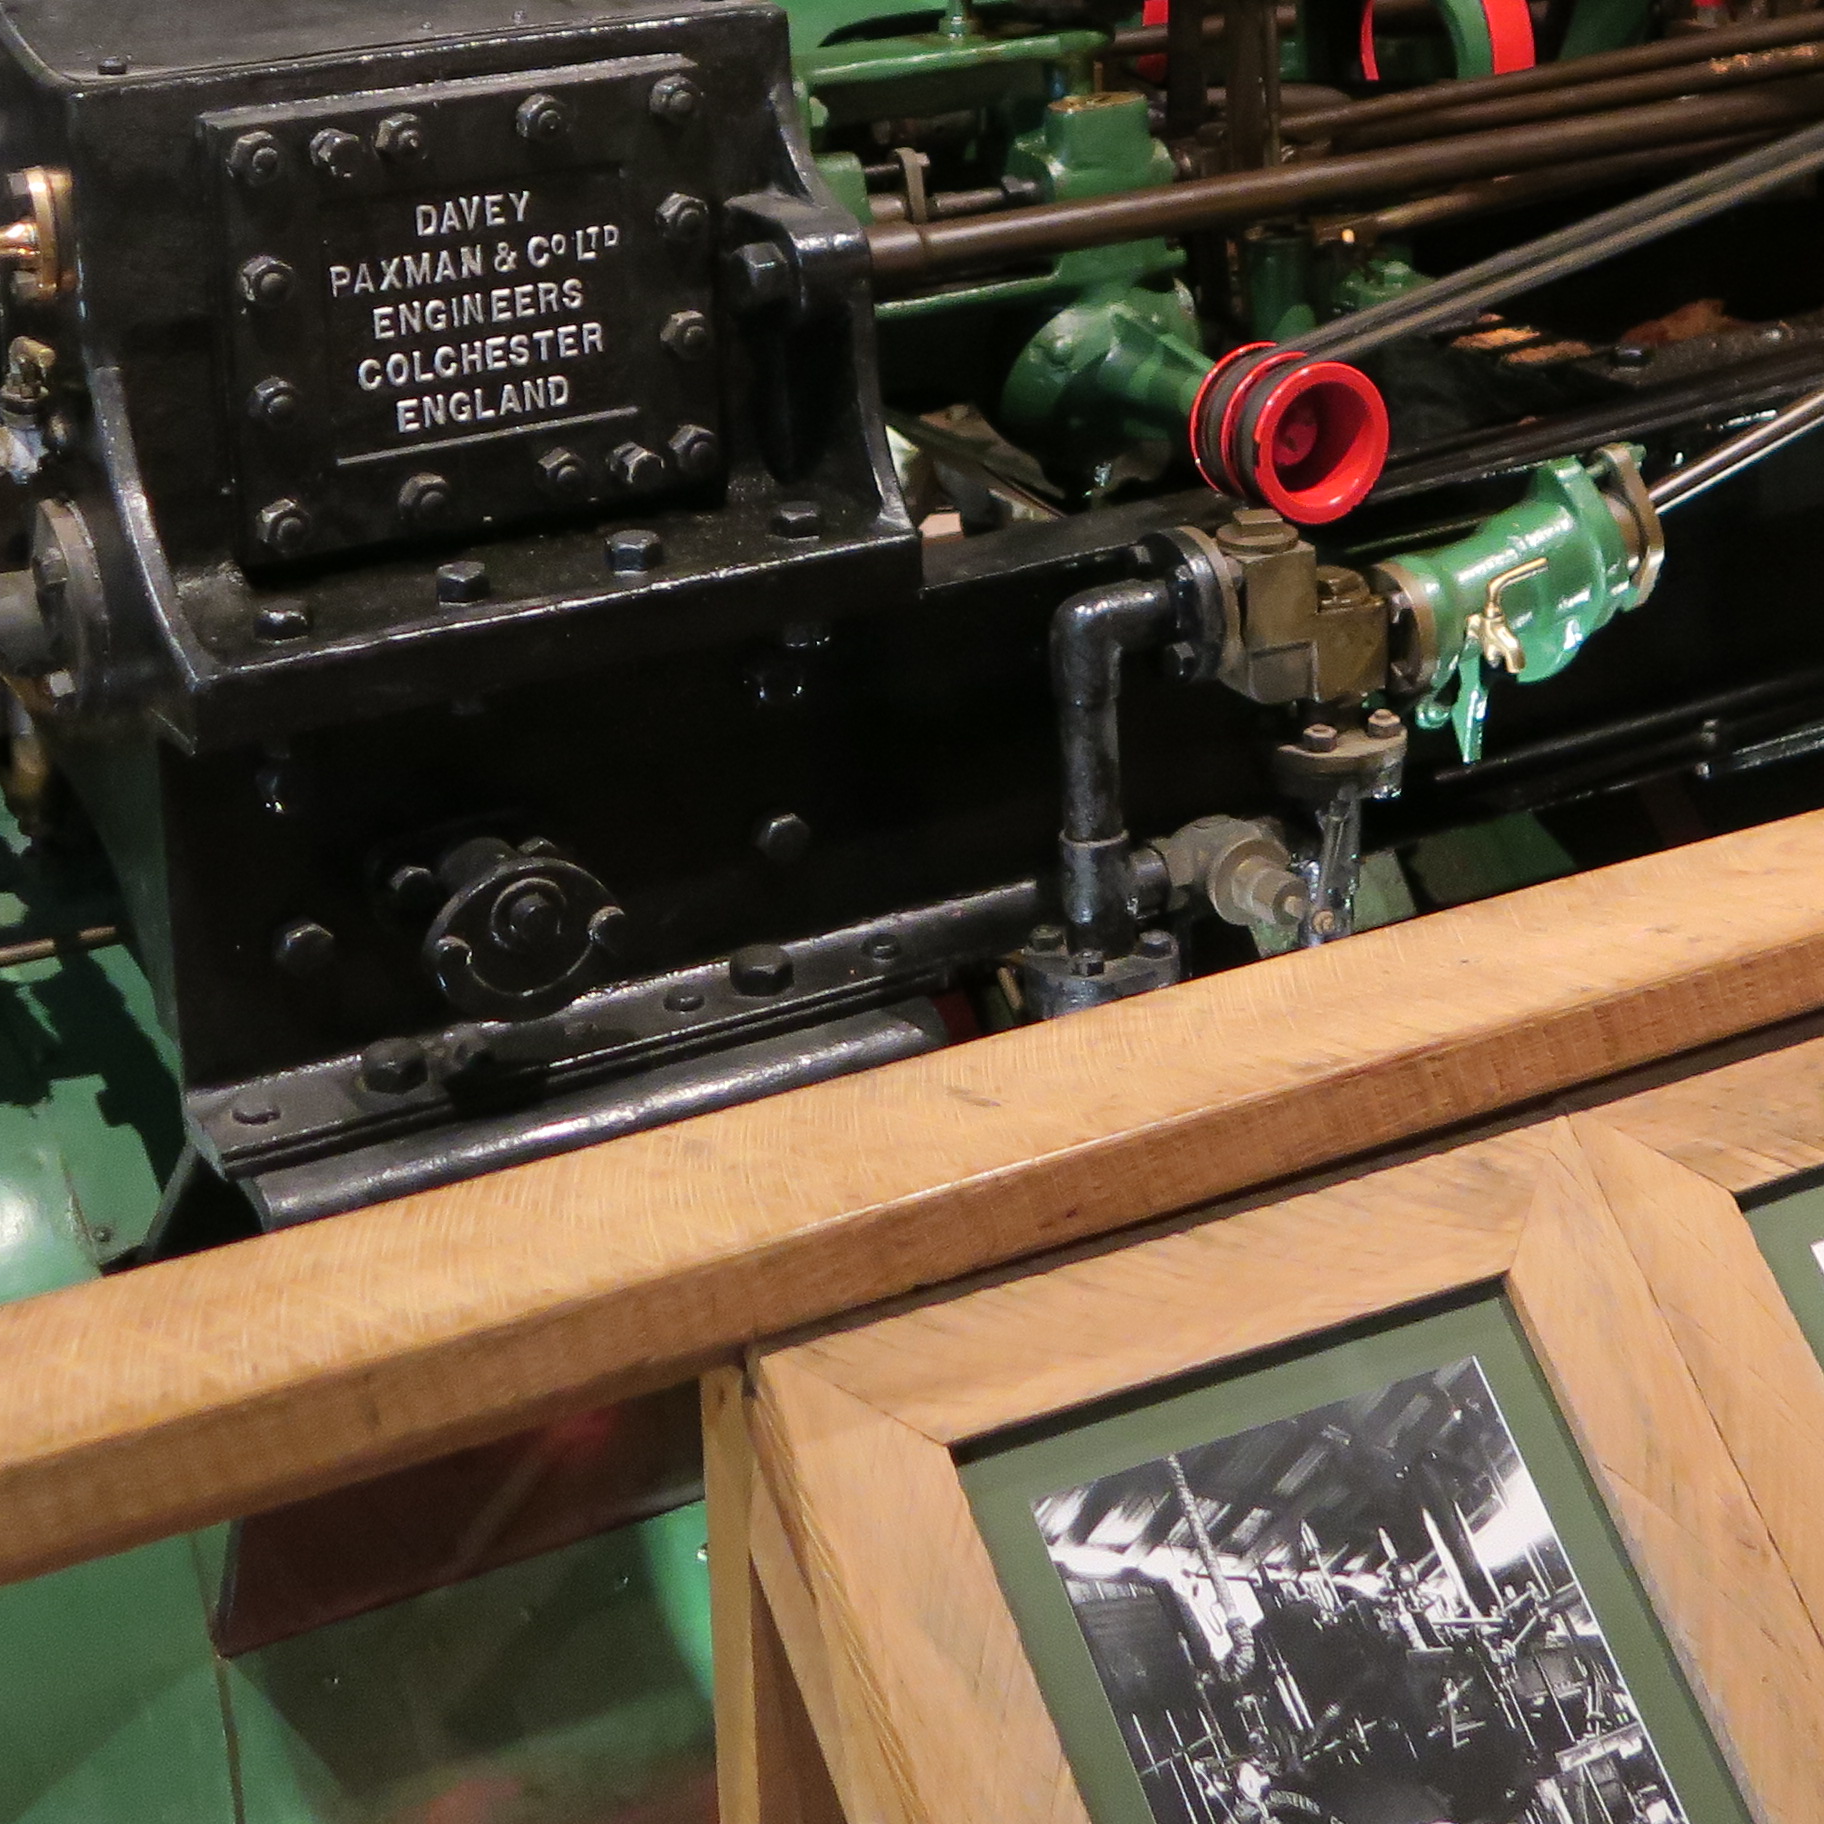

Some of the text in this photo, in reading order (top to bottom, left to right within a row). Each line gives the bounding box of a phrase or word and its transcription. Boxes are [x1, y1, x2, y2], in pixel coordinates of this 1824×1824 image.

[416, 190, 530, 237] DAVEY
[329, 243, 483, 298] PAXMAN
[494, 241, 517, 272] &
[373, 278, 584, 340] ENGINEERS
[357, 322, 604, 392] COLCHESTER
[395, 374, 569, 434] ENGLAND
